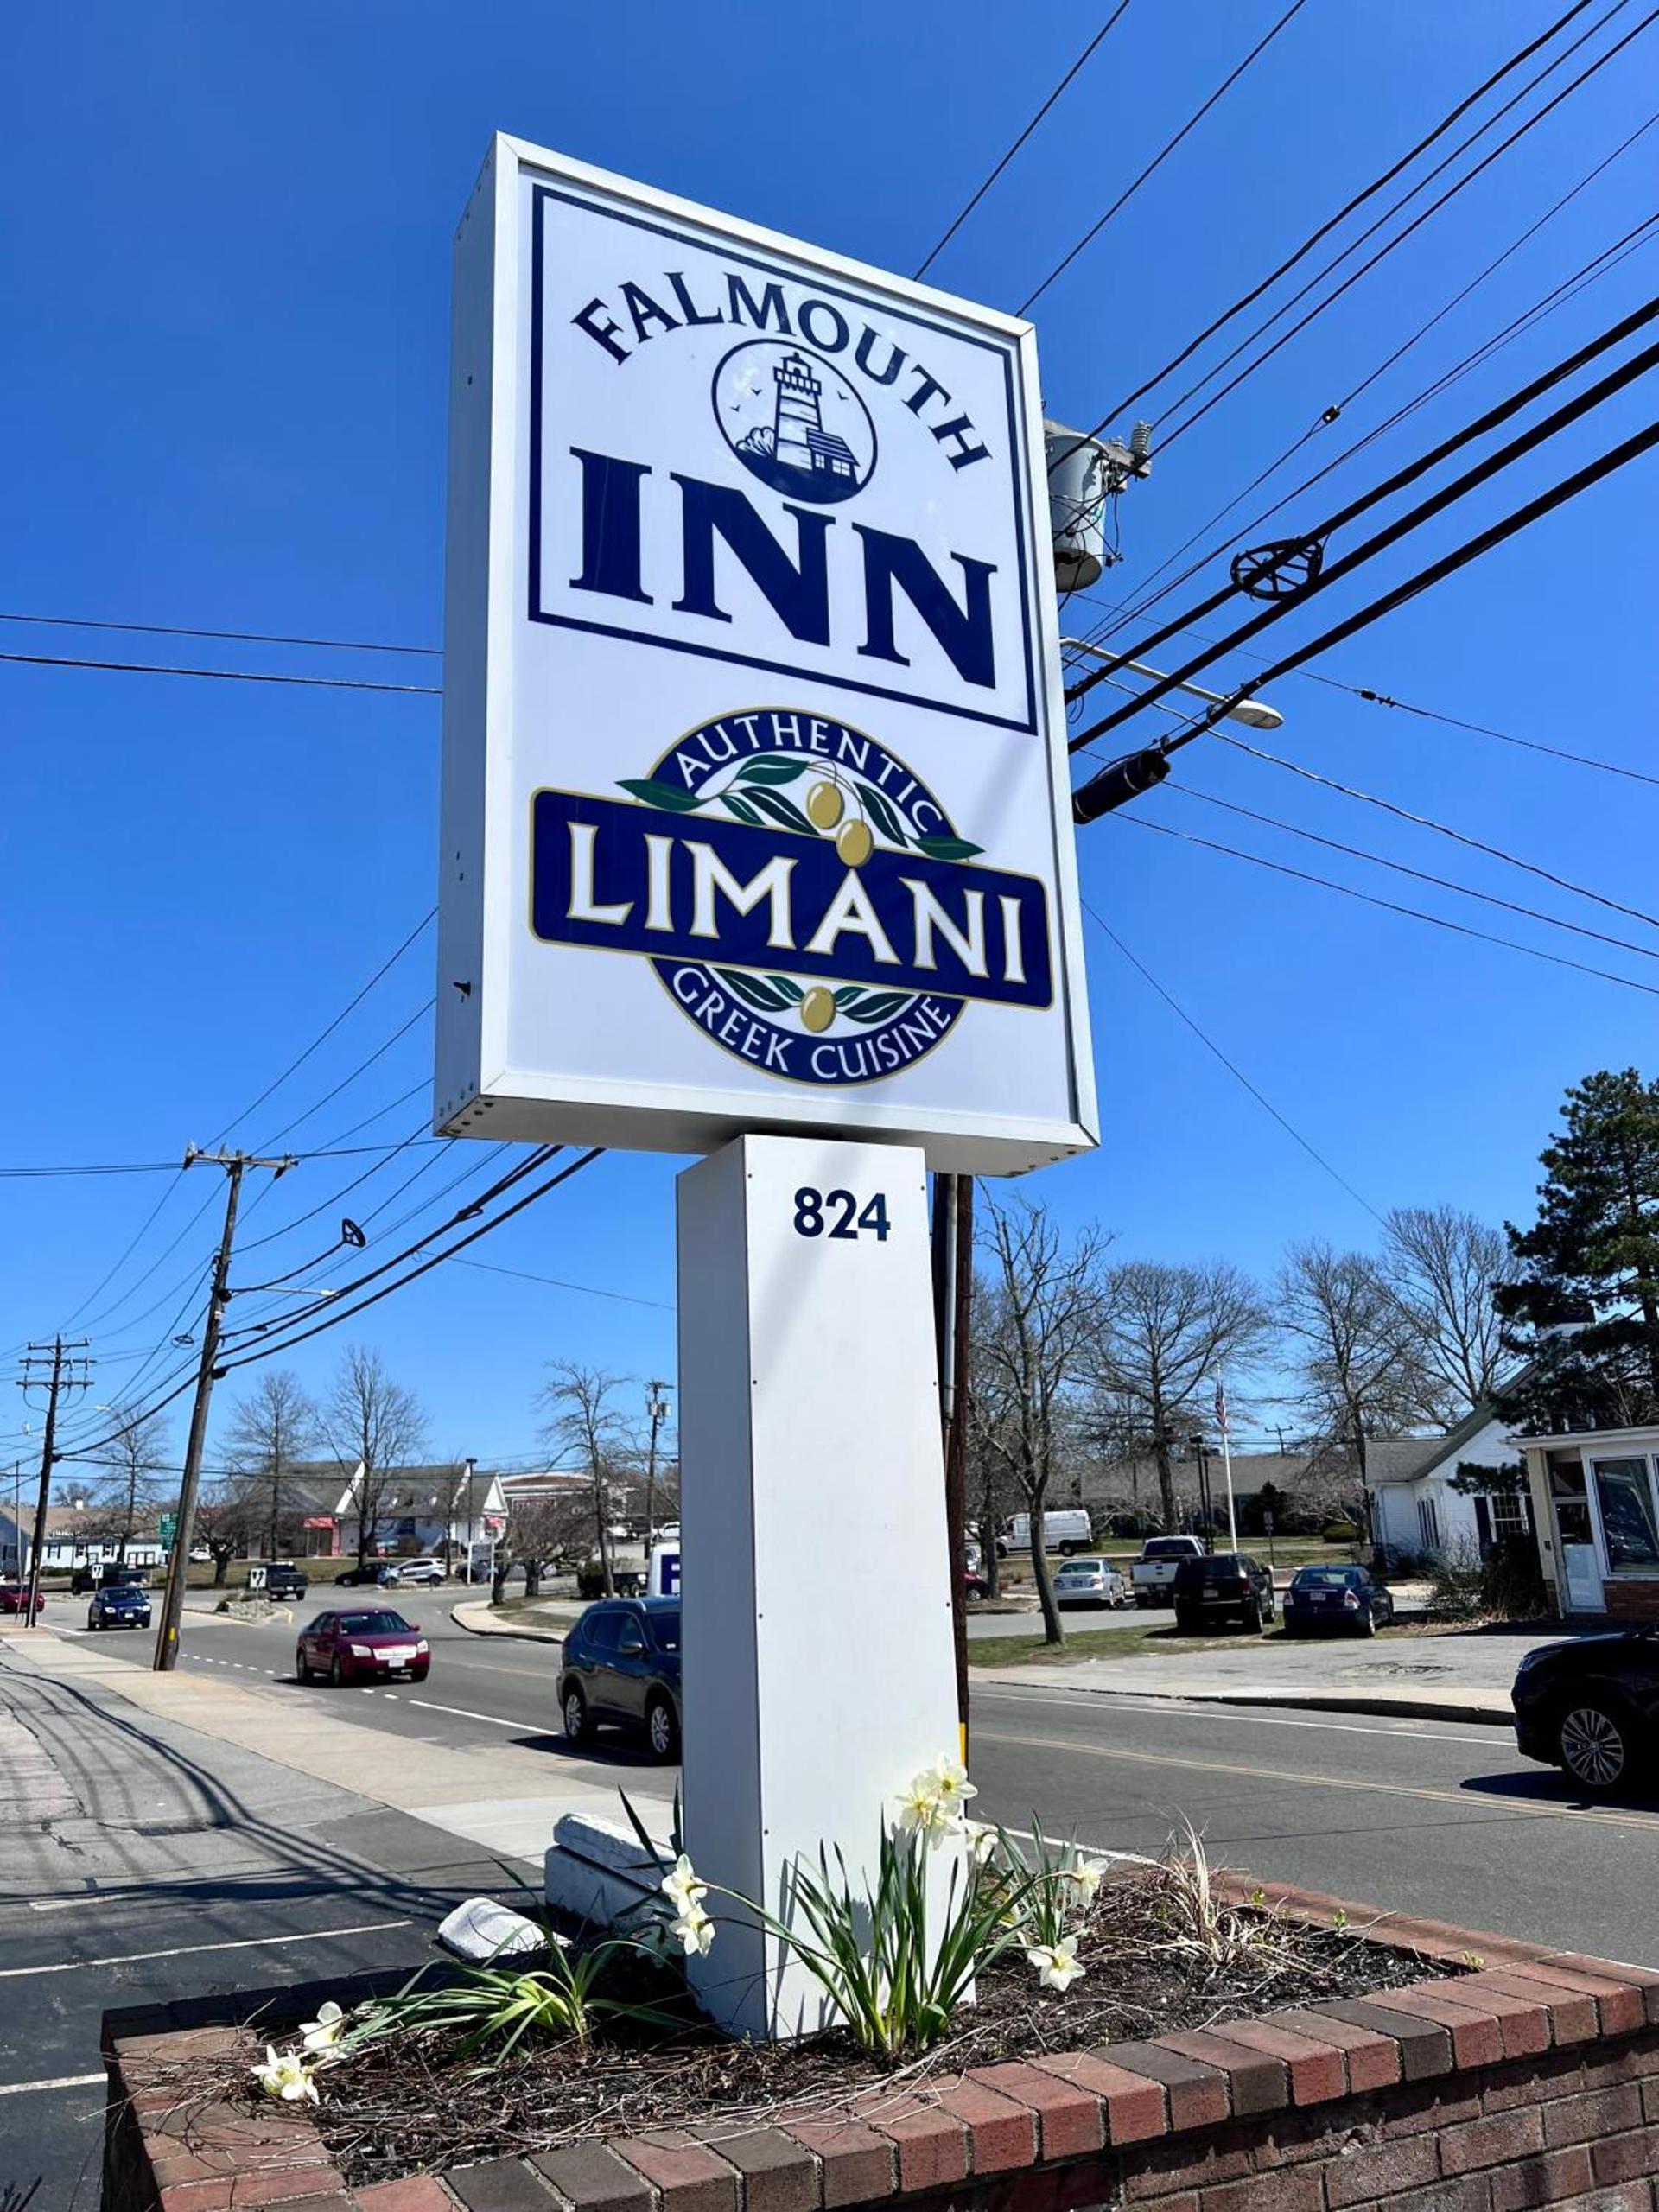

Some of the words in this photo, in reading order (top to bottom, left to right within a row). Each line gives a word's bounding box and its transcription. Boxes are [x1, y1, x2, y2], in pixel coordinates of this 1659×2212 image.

[570, 271, 994, 473] FALMOUTH
[569, 446, 998, 690] INN
[674, 714, 944, 834] AUTHENTIC
[567, 822, 1027, 984] LIMANI
[673, 967, 794, 1072] GREEK
[810, 996, 950, 1079] CUISINE
[793, 1187, 892, 1241] 824
